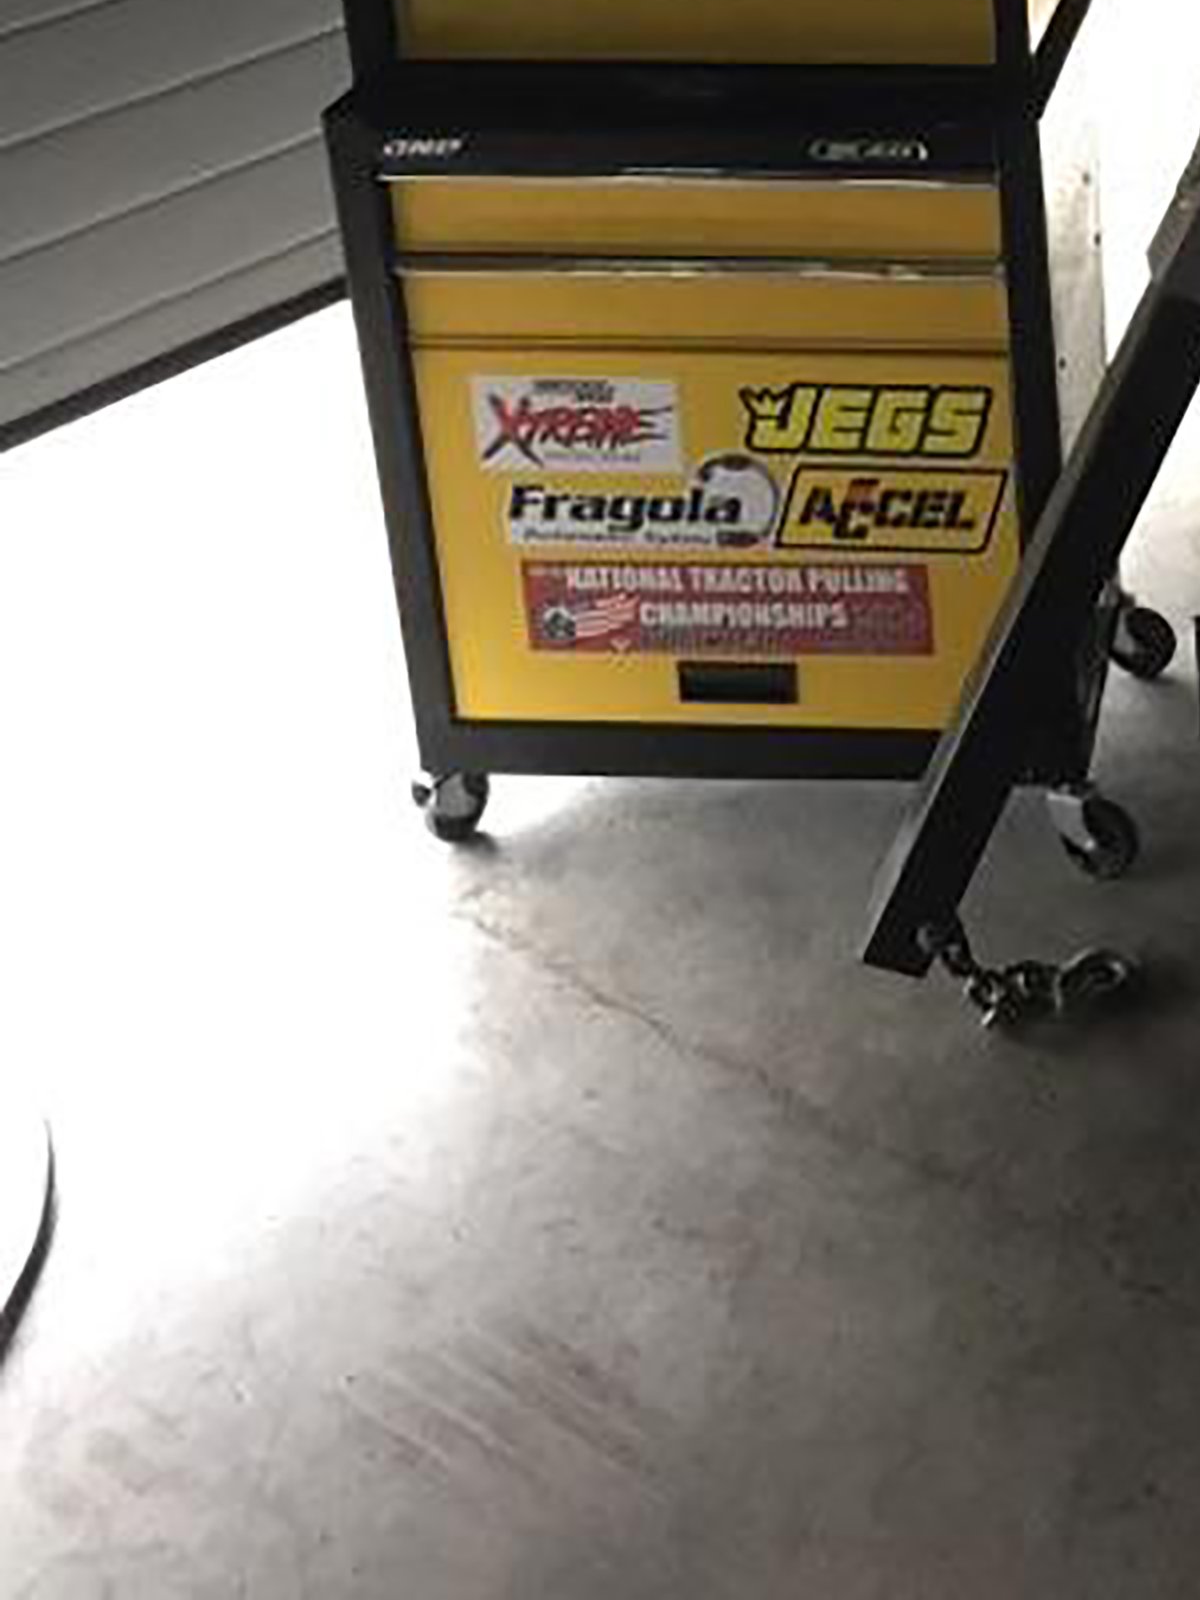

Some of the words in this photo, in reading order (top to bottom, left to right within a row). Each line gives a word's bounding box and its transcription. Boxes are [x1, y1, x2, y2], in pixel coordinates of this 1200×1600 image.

[745, 384, 994, 459] JEGS
[508, 484, 742, 532] Fragola
[798, 478, 975, 540] ACCEL
[566, 566, 683, 592] NATIONAL
[691, 567, 803, 593] TRACTOR
[808, 567, 910, 593] PULLING
[639, 603, 848, 629] CHAMPIONSHIPS
